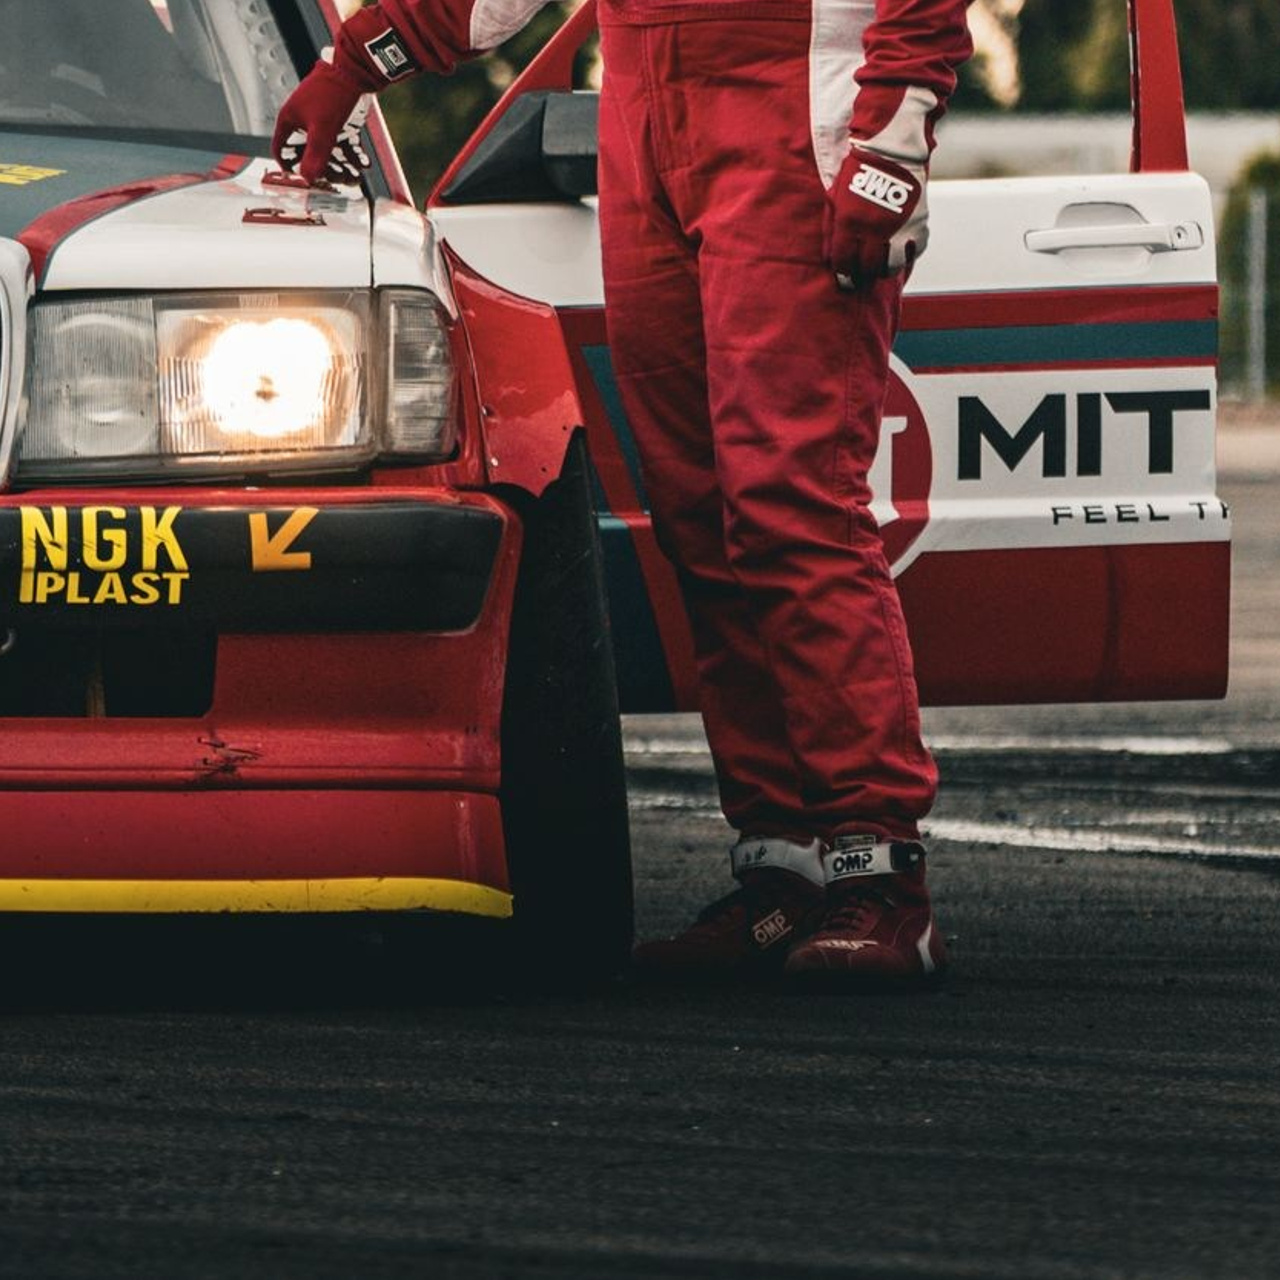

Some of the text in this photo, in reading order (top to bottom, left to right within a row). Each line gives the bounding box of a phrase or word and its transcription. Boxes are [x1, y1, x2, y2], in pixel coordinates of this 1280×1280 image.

[851, 167, 909, 208] OMP
[958, 389, 1210, 480] MIT
[1051, 504, 1170, 525] FEEL
[20, 505, 190, 572] NGK
[833, 852, 873, 873] OMP
[754, 913, 787, 944] OMP
